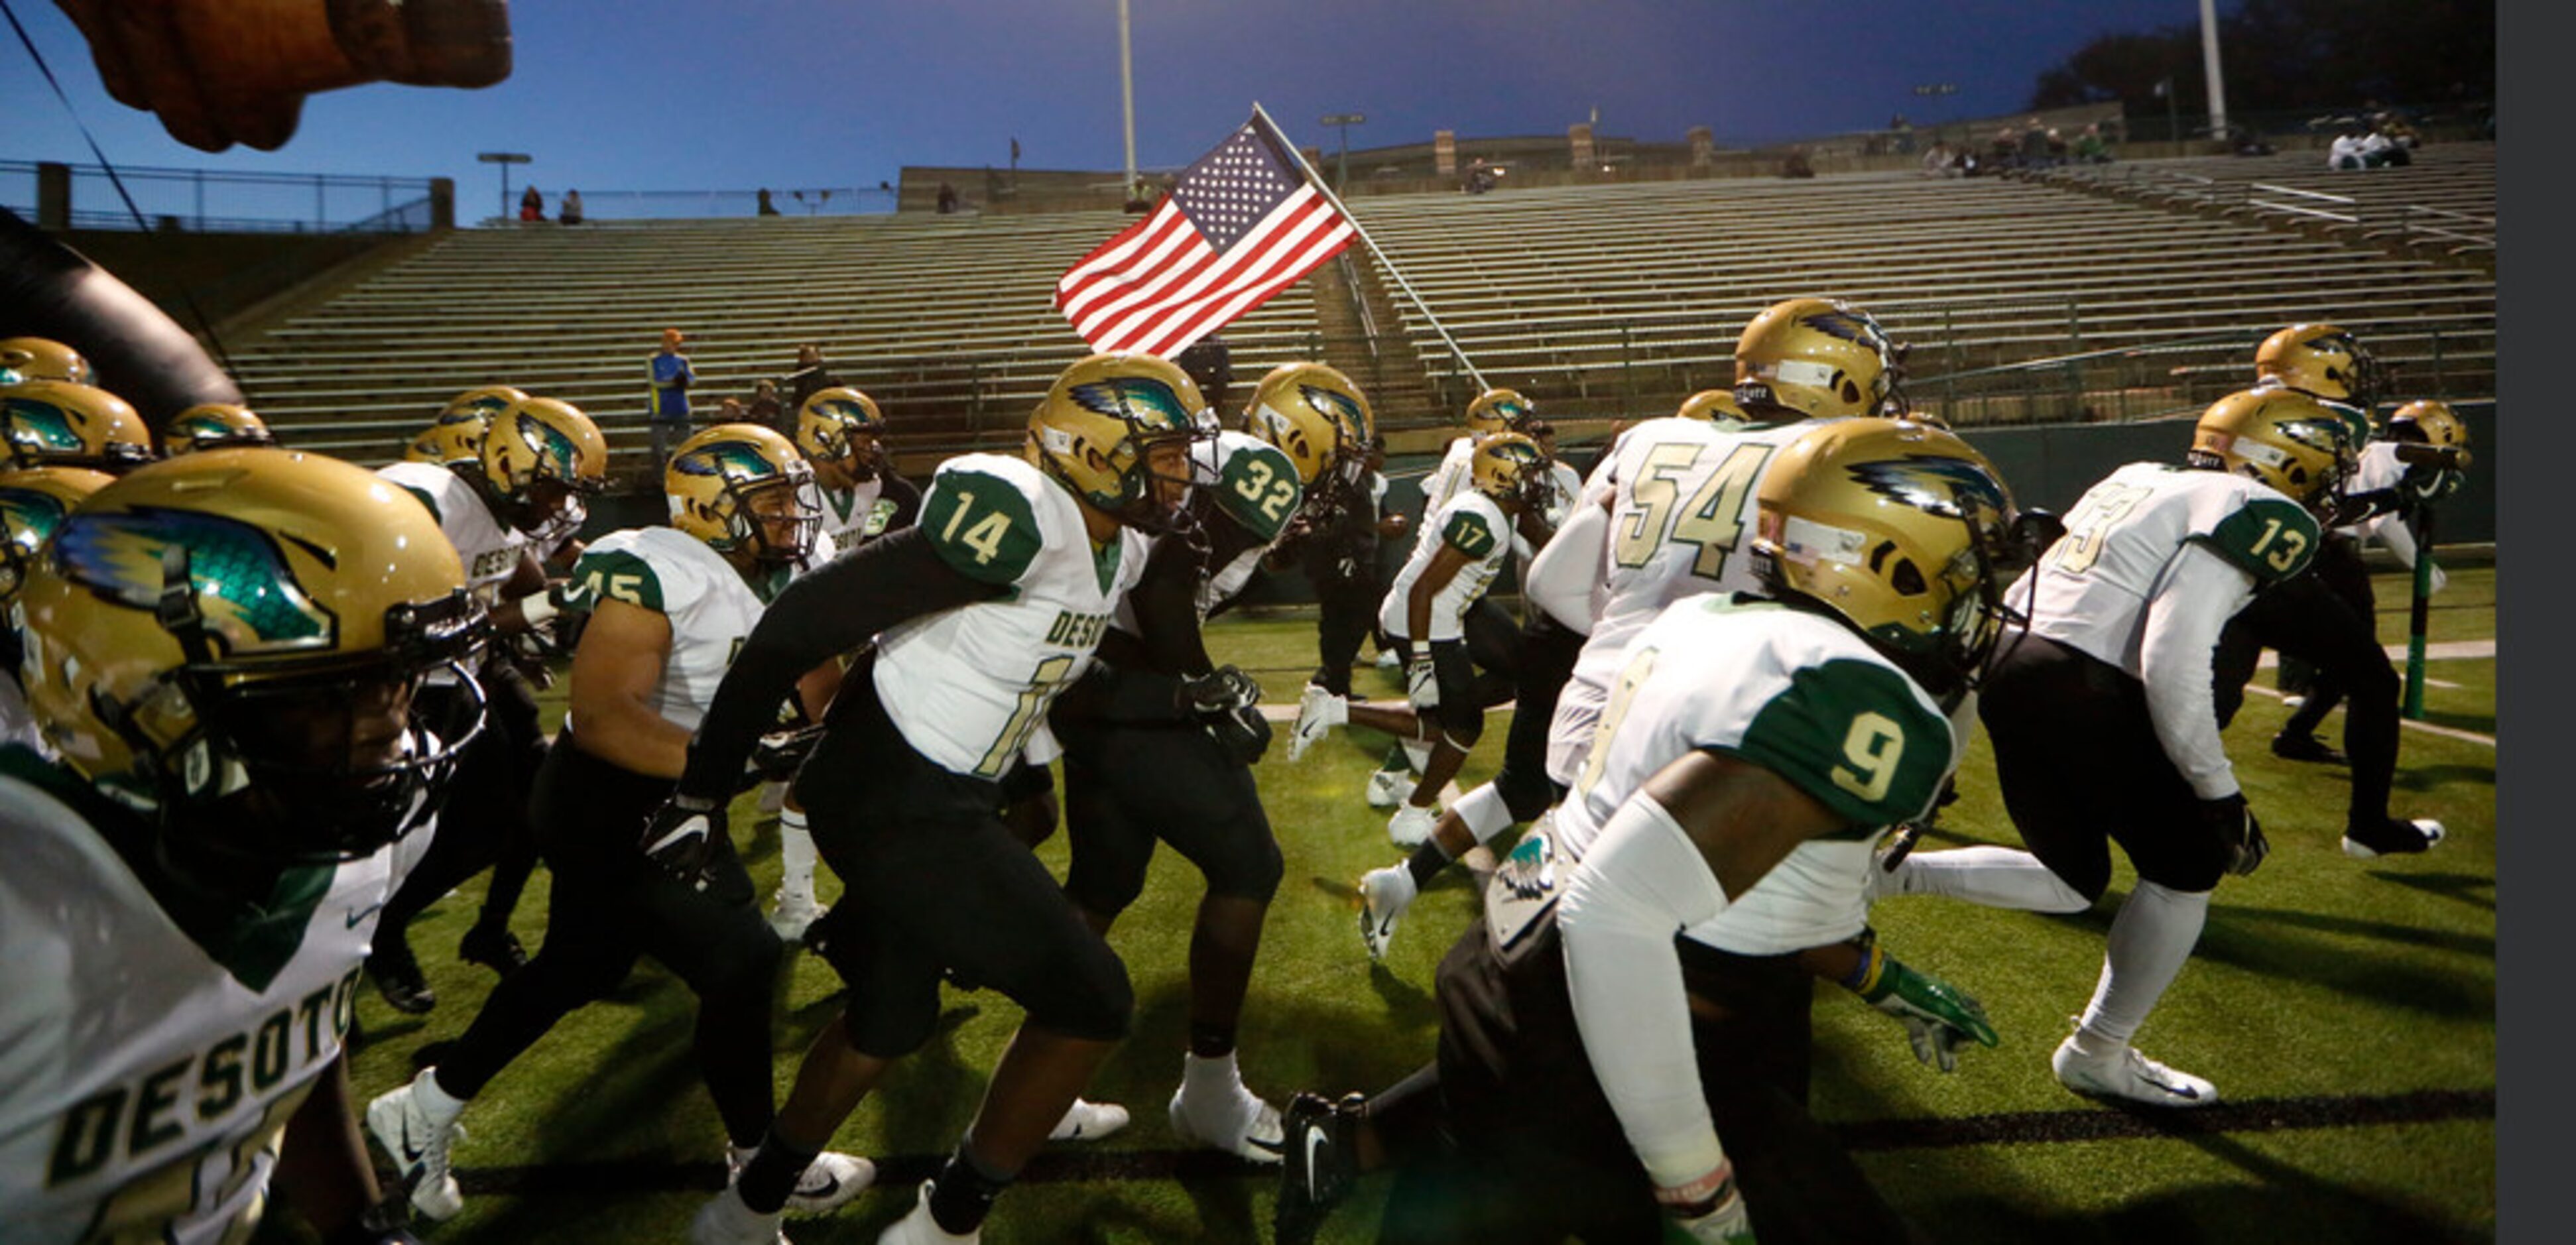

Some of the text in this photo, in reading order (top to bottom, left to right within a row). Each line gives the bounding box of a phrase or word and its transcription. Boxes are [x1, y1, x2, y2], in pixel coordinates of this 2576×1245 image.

[1235, 459, 1294, 521] 32
[1615, 442, 1776, 581] 54
[942, 491, 1012, 565] 14
[1455, 521, 1486, 549] 17
[2250, 518, 2308, 572] 13
[1830, 710, 1906, 801] 9
[45, 965, 363, 1190] DESOTO
